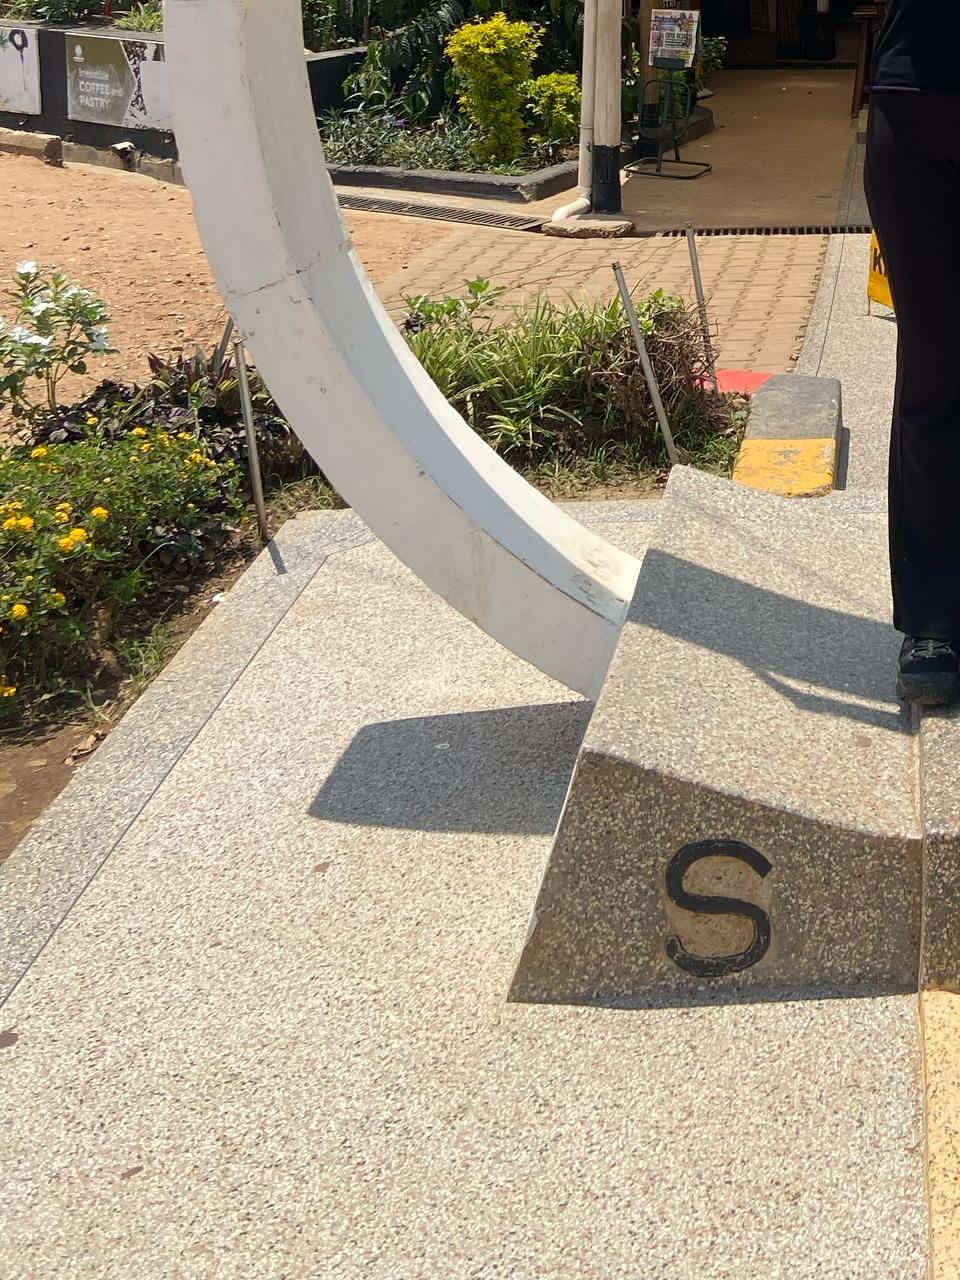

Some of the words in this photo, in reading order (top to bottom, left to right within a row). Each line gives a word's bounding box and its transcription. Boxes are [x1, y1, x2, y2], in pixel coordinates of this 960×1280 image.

[79, 81, 110, 96] COFFEE
[79, 95, 111, 112] PASTRY
[664, 839, 773, 979] S
